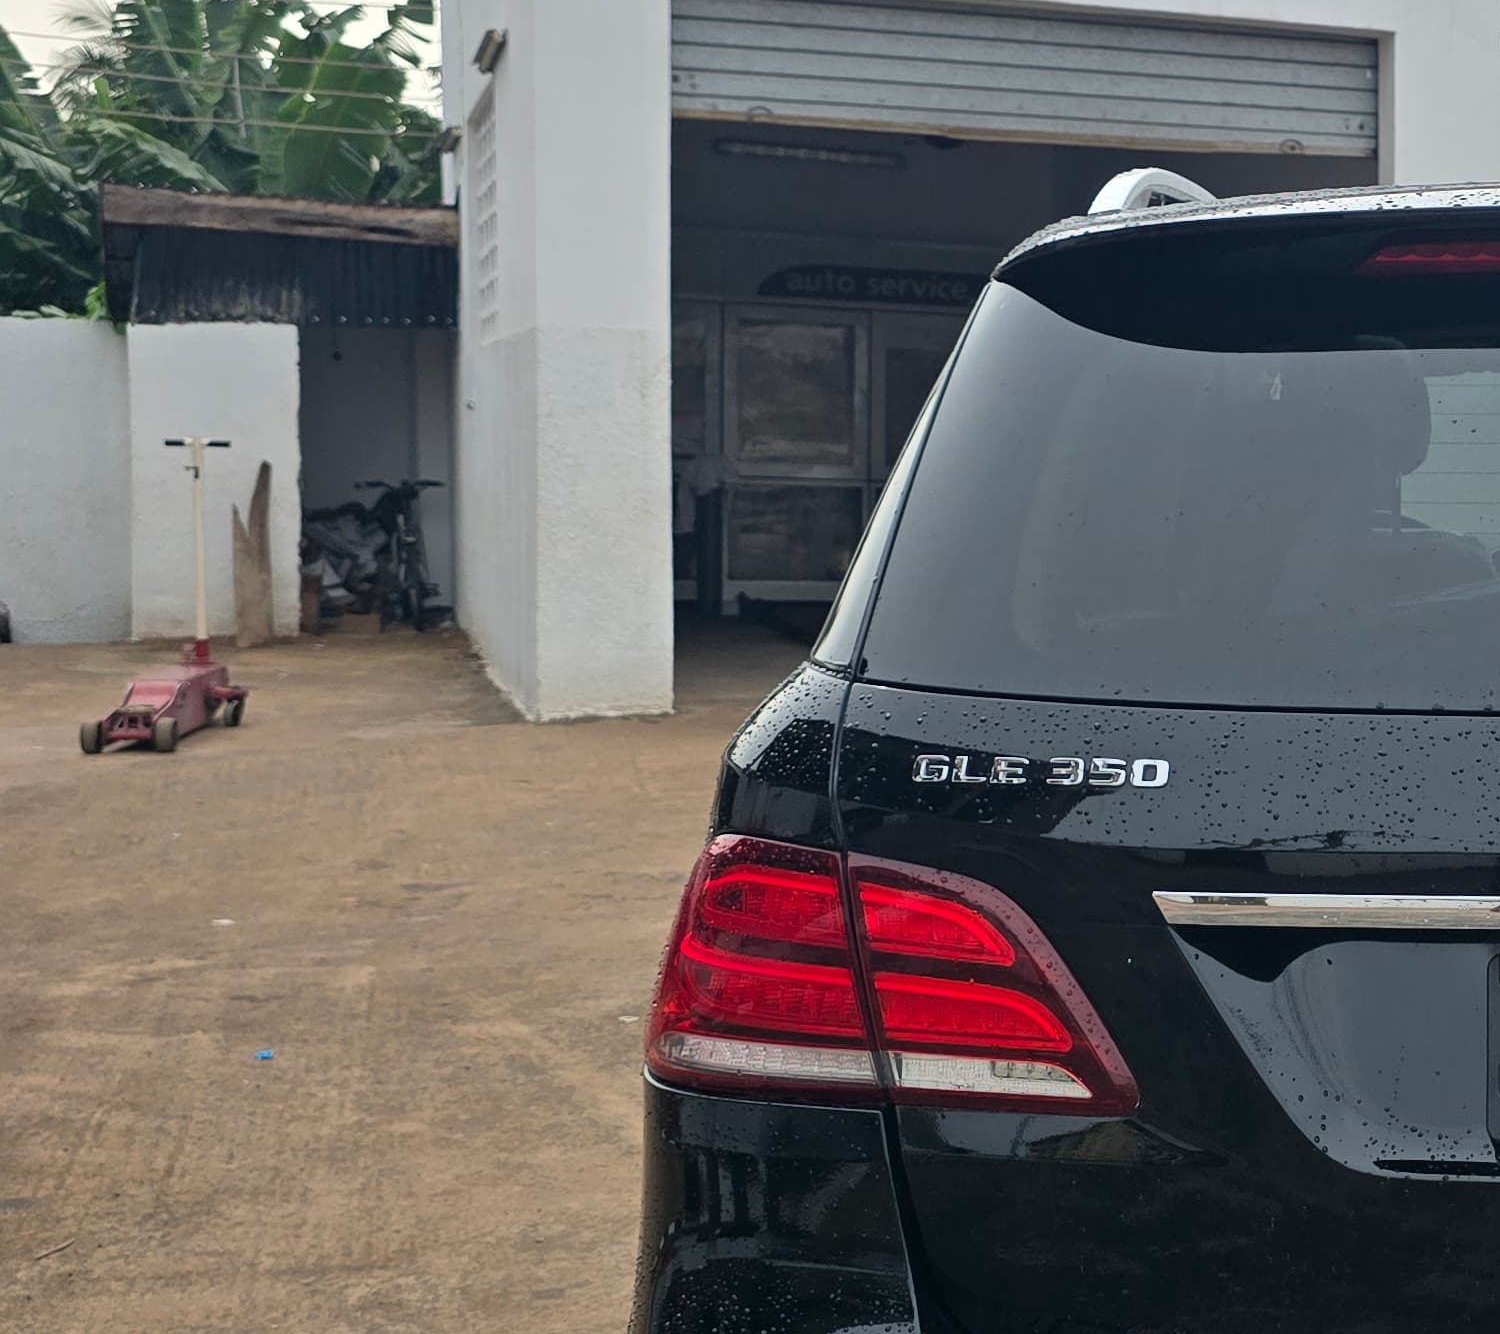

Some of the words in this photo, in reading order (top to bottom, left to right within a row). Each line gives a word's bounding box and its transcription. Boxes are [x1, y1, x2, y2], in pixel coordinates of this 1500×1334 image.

[786, 270, 857, 292] auto
[866, 275, 970, 300] service
[912, 754, 1031, 785] GLE
[1045, 757, 1170, 788] 350
